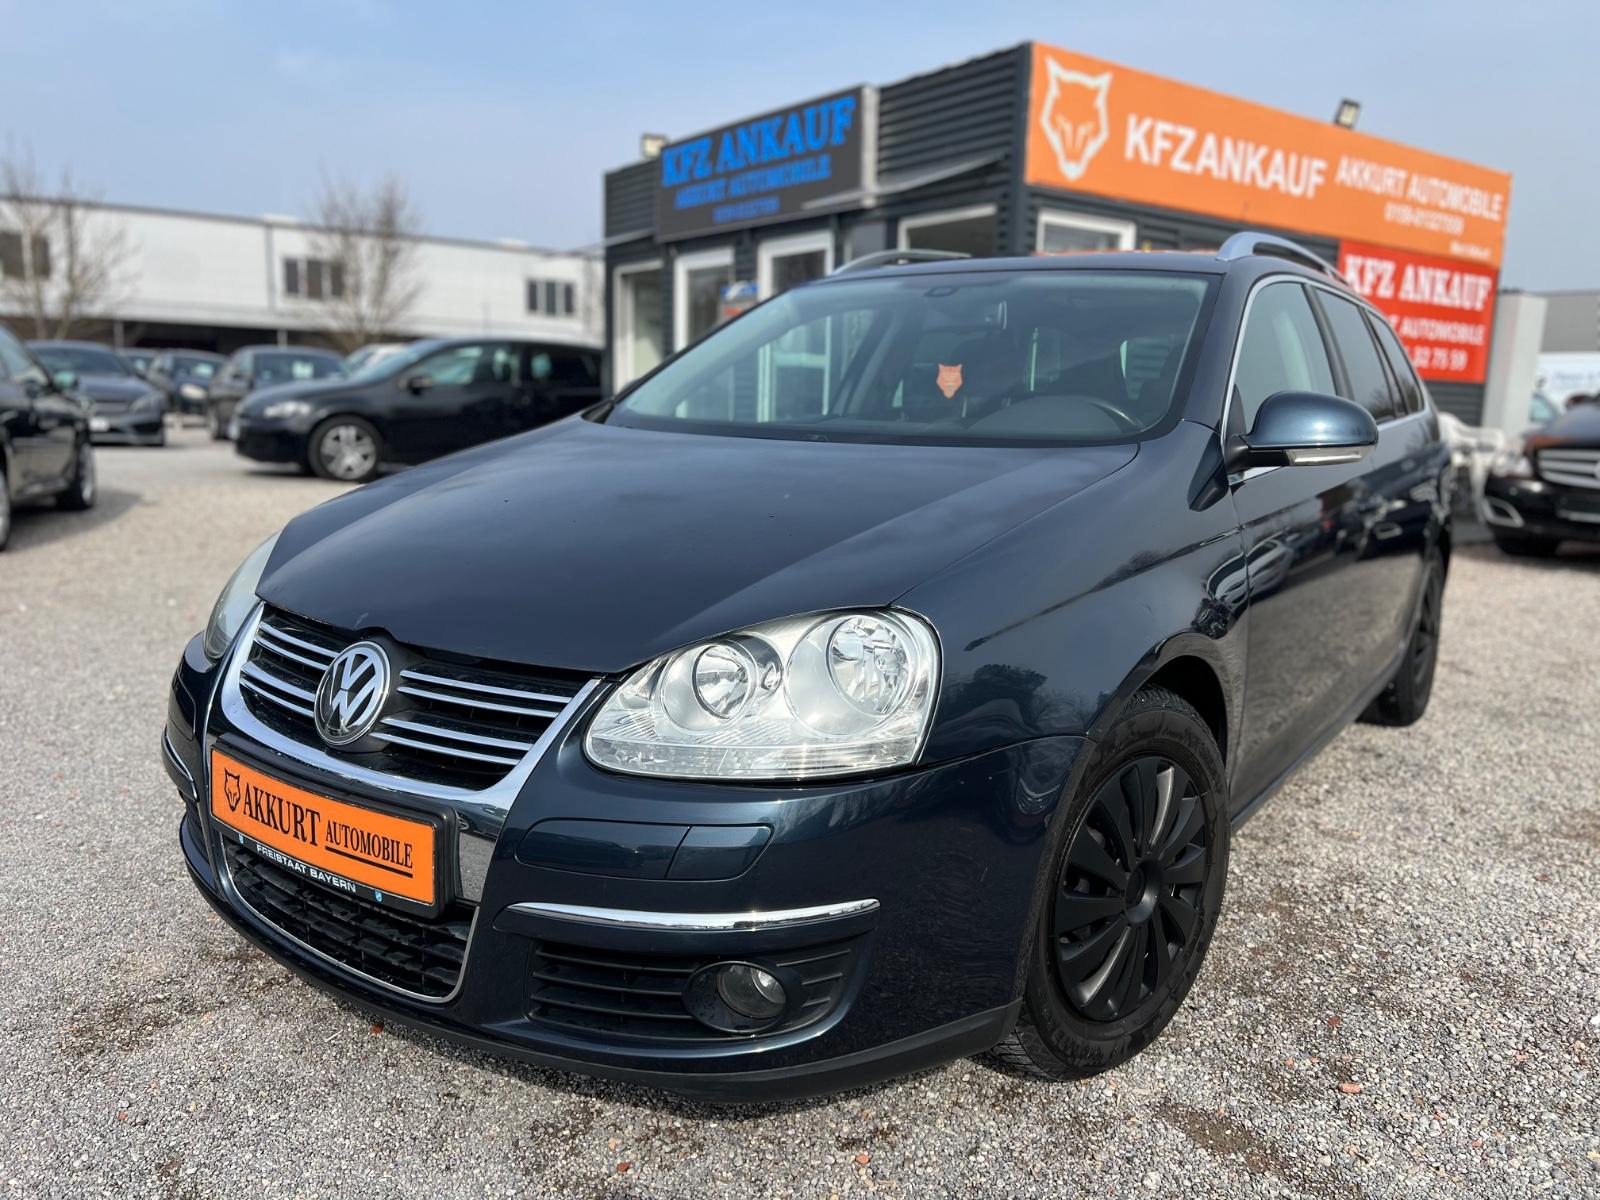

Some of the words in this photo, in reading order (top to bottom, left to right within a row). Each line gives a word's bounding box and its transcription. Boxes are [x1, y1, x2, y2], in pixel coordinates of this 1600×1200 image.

[662, 137, 712, 188] KFZ
[716, 96, 856, 174] ANKAUF
[1335, 156, 1407, 197] AKKURT
[1406, 173, 1504, 222] AUTOMOBILE
[1343, 254, 1396, 298] KFZ
[1399, 263, 1492, 311] ANKAUF
[1400, 316, 1485, 346] AUTOMOBILE
[243, 782, 321, 847] AKKURT
[325, 819, 413, 869] AUTOMOBILE
[256, 843, 307, 875] FREISTAAT
[310, 869, 357, 894] BAYERN
